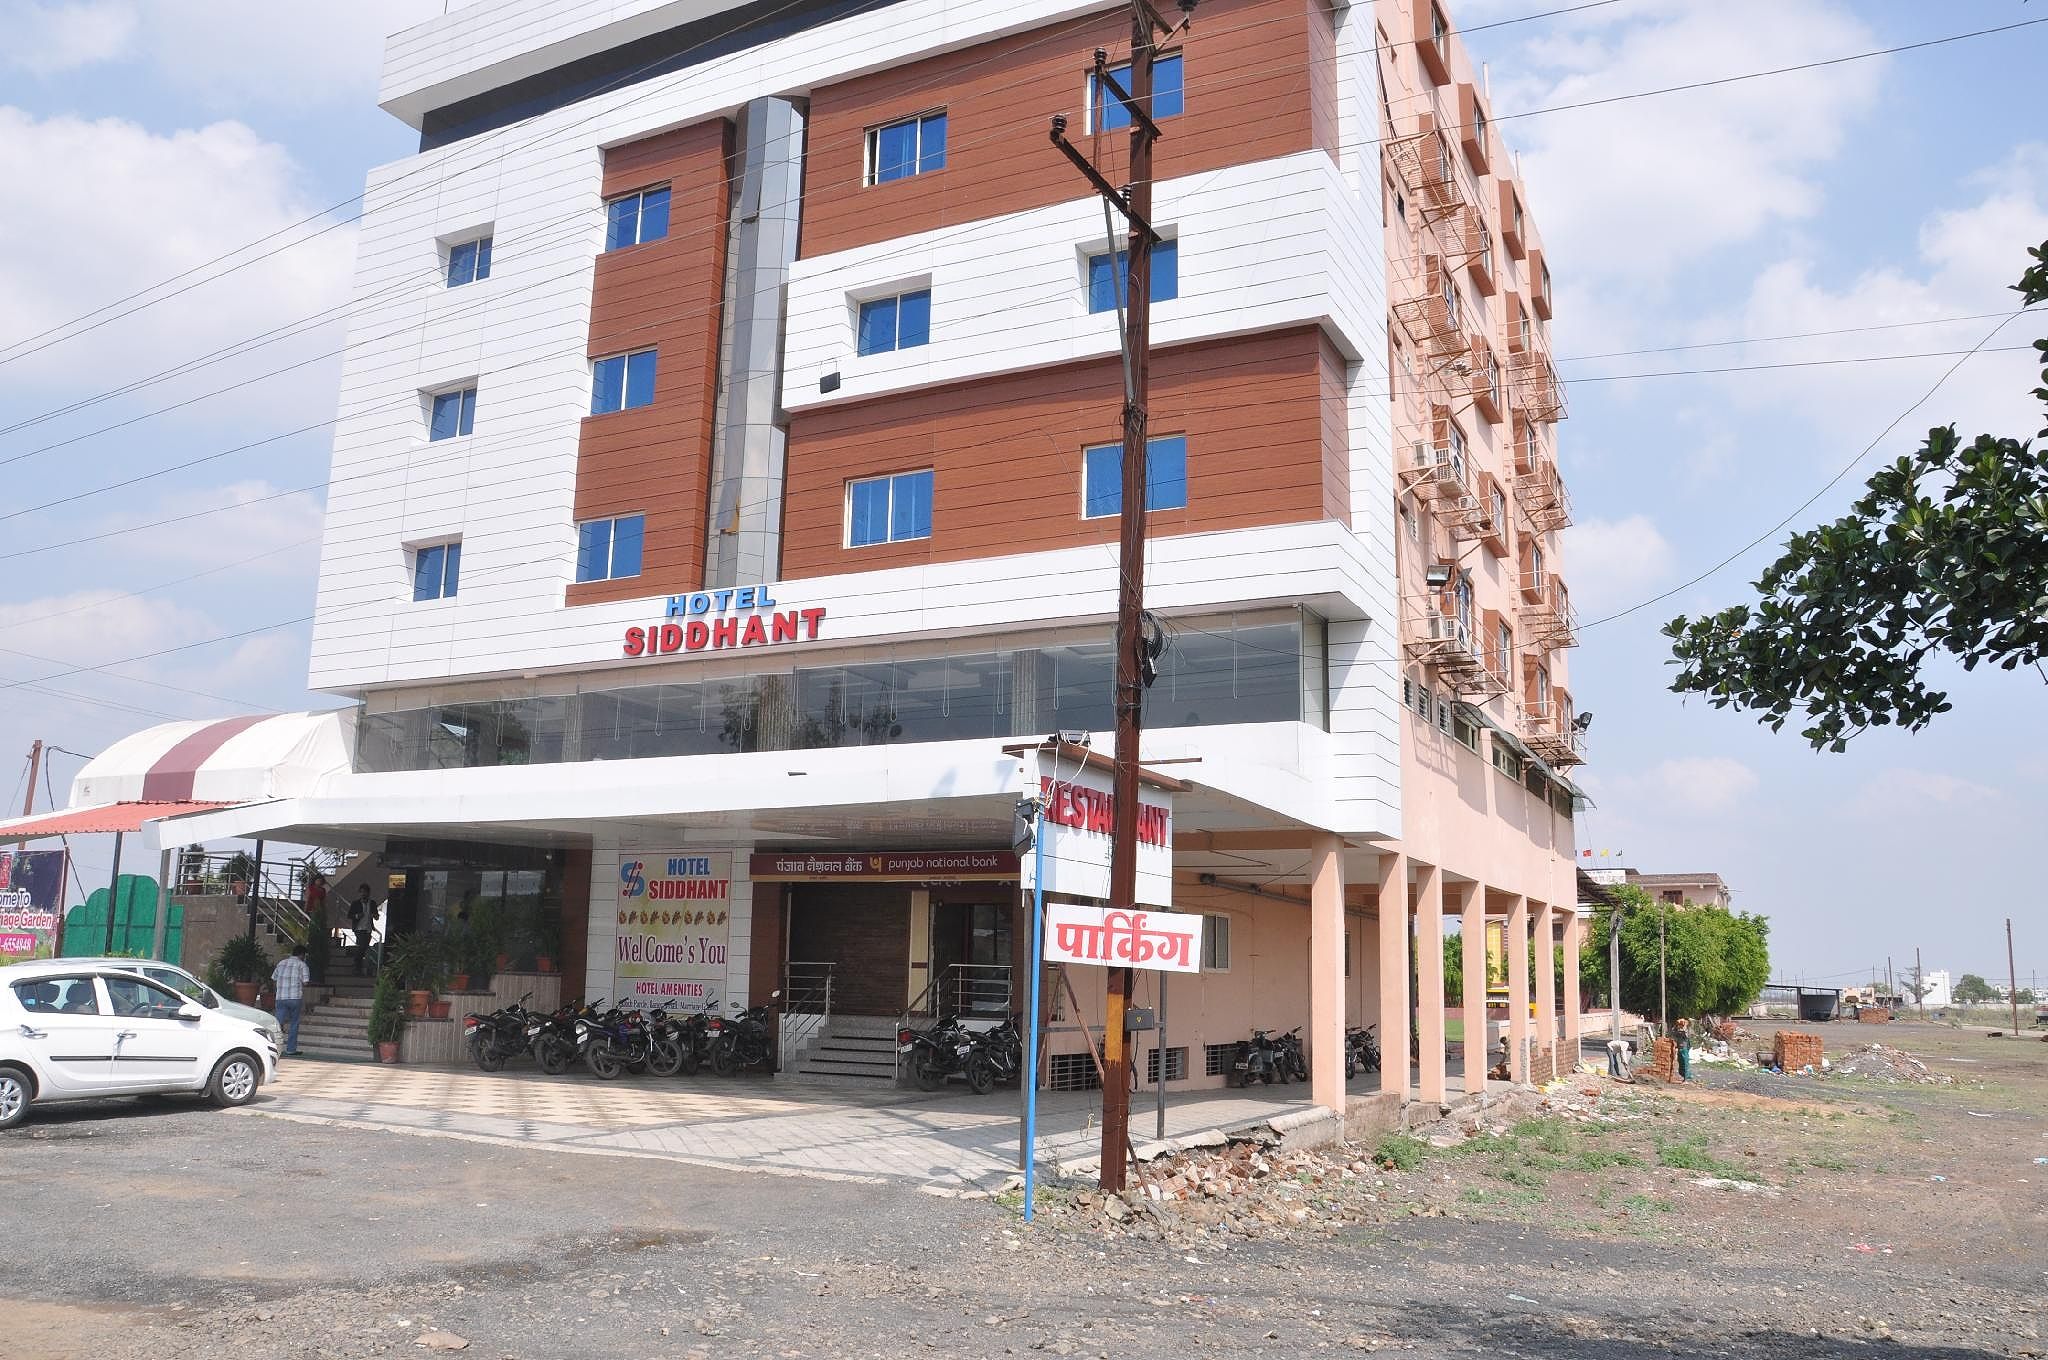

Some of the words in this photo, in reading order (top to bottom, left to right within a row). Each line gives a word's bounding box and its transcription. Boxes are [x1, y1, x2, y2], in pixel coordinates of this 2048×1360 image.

[665, 585, 776, 617] HOTEL
[623, 607, 827, 656] SIDDHANT
[1040, 776, 1169, 846] RESTAANT
[667, 858, 710, 876] HOTEL
[888, 857, 924, 871] punjab
[926, 855, 970, 868] national
[972, 854, 998, 867] bank
[19, 890, 30, 906] To
[648, 879, 728, 899] SIDDHANT
[21, 910, 52, 927] Garden
[699, 937, 726, 965] You
[635, 981, 658, 995] HOTEL
[660, 983, 703, 997] AMENITIES
